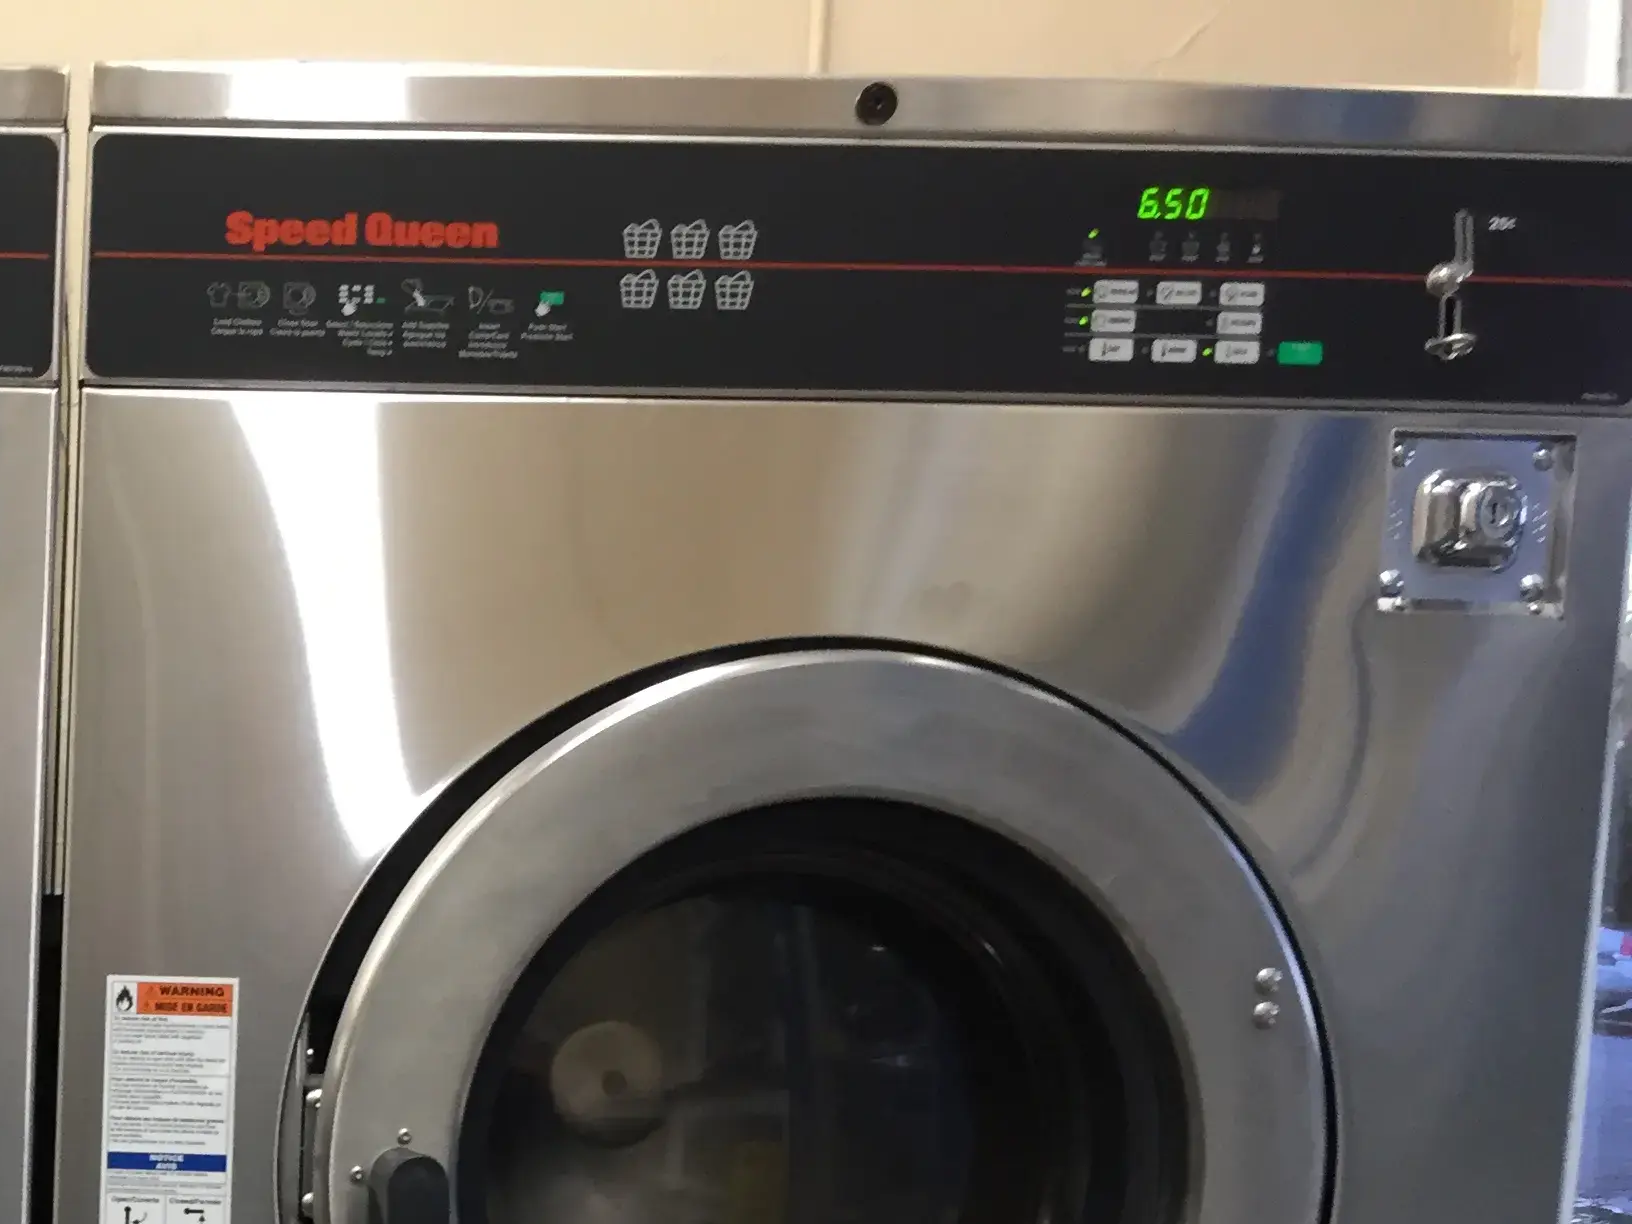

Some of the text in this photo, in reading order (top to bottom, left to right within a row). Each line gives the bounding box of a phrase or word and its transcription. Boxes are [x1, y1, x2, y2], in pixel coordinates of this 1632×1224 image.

[1137, 186, 1210, 220] 6.50
[225, 210, 500, 252] Speed Queen
[160, 985, 224, 997] WARNING
